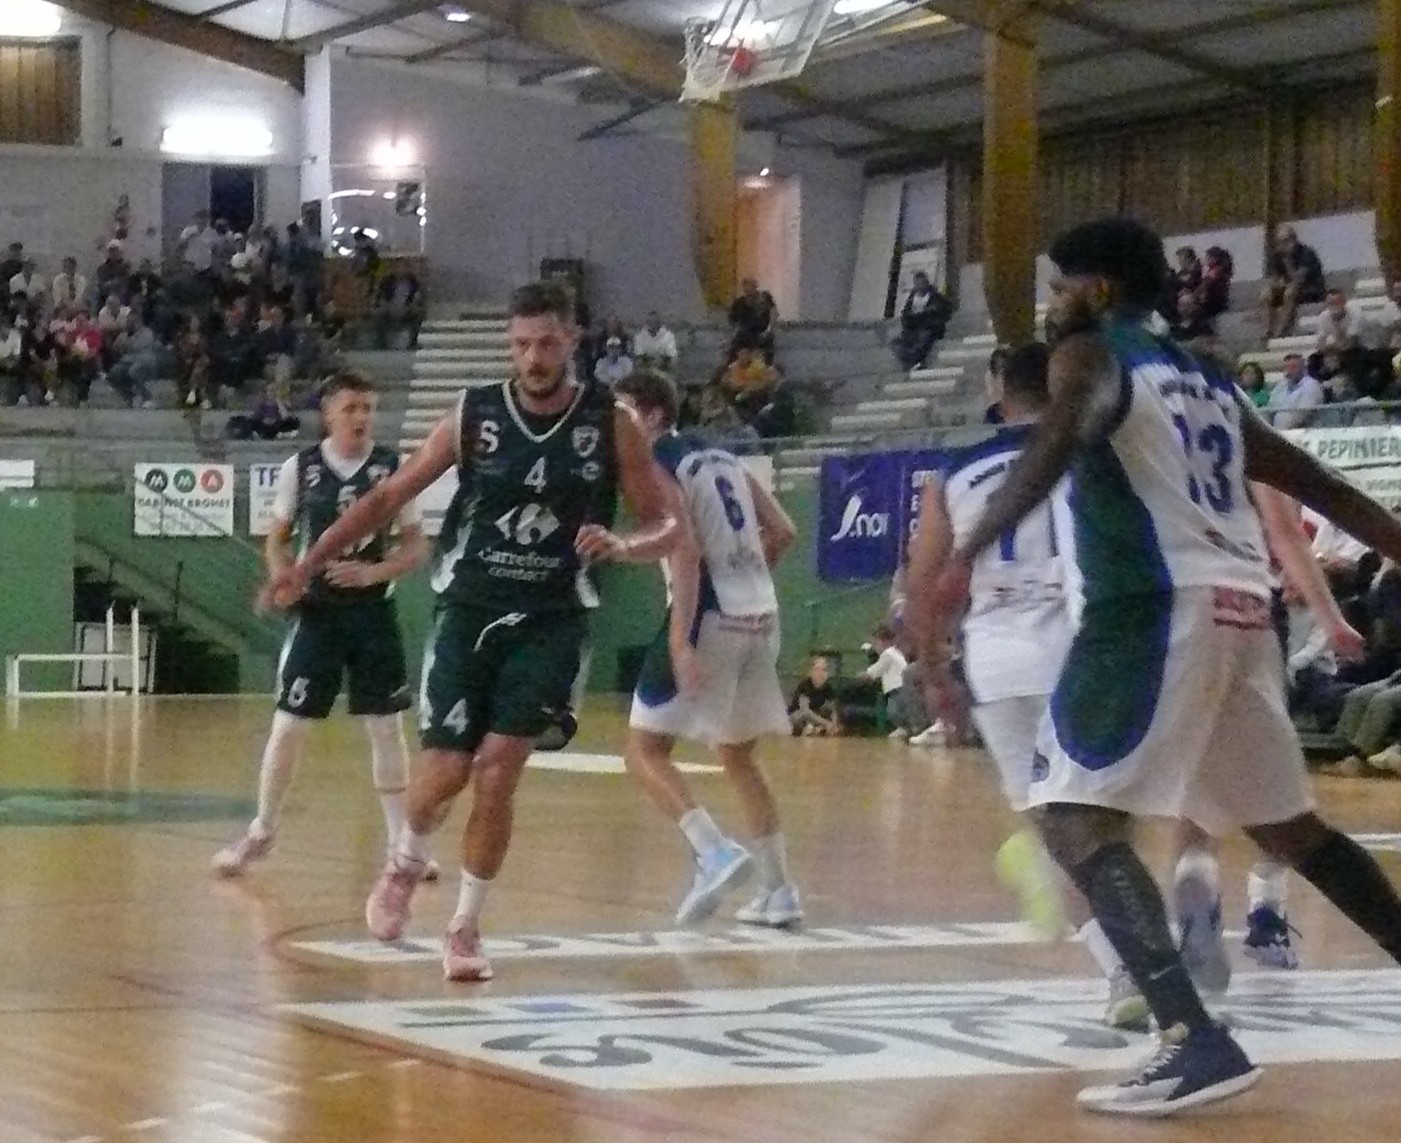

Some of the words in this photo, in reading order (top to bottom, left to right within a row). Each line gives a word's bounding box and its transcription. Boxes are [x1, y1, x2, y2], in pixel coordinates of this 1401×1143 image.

[523, 455, 547, 494] 4
[1171, 413, 1233, 514] 13
[441, 698, 468, 736] 4
